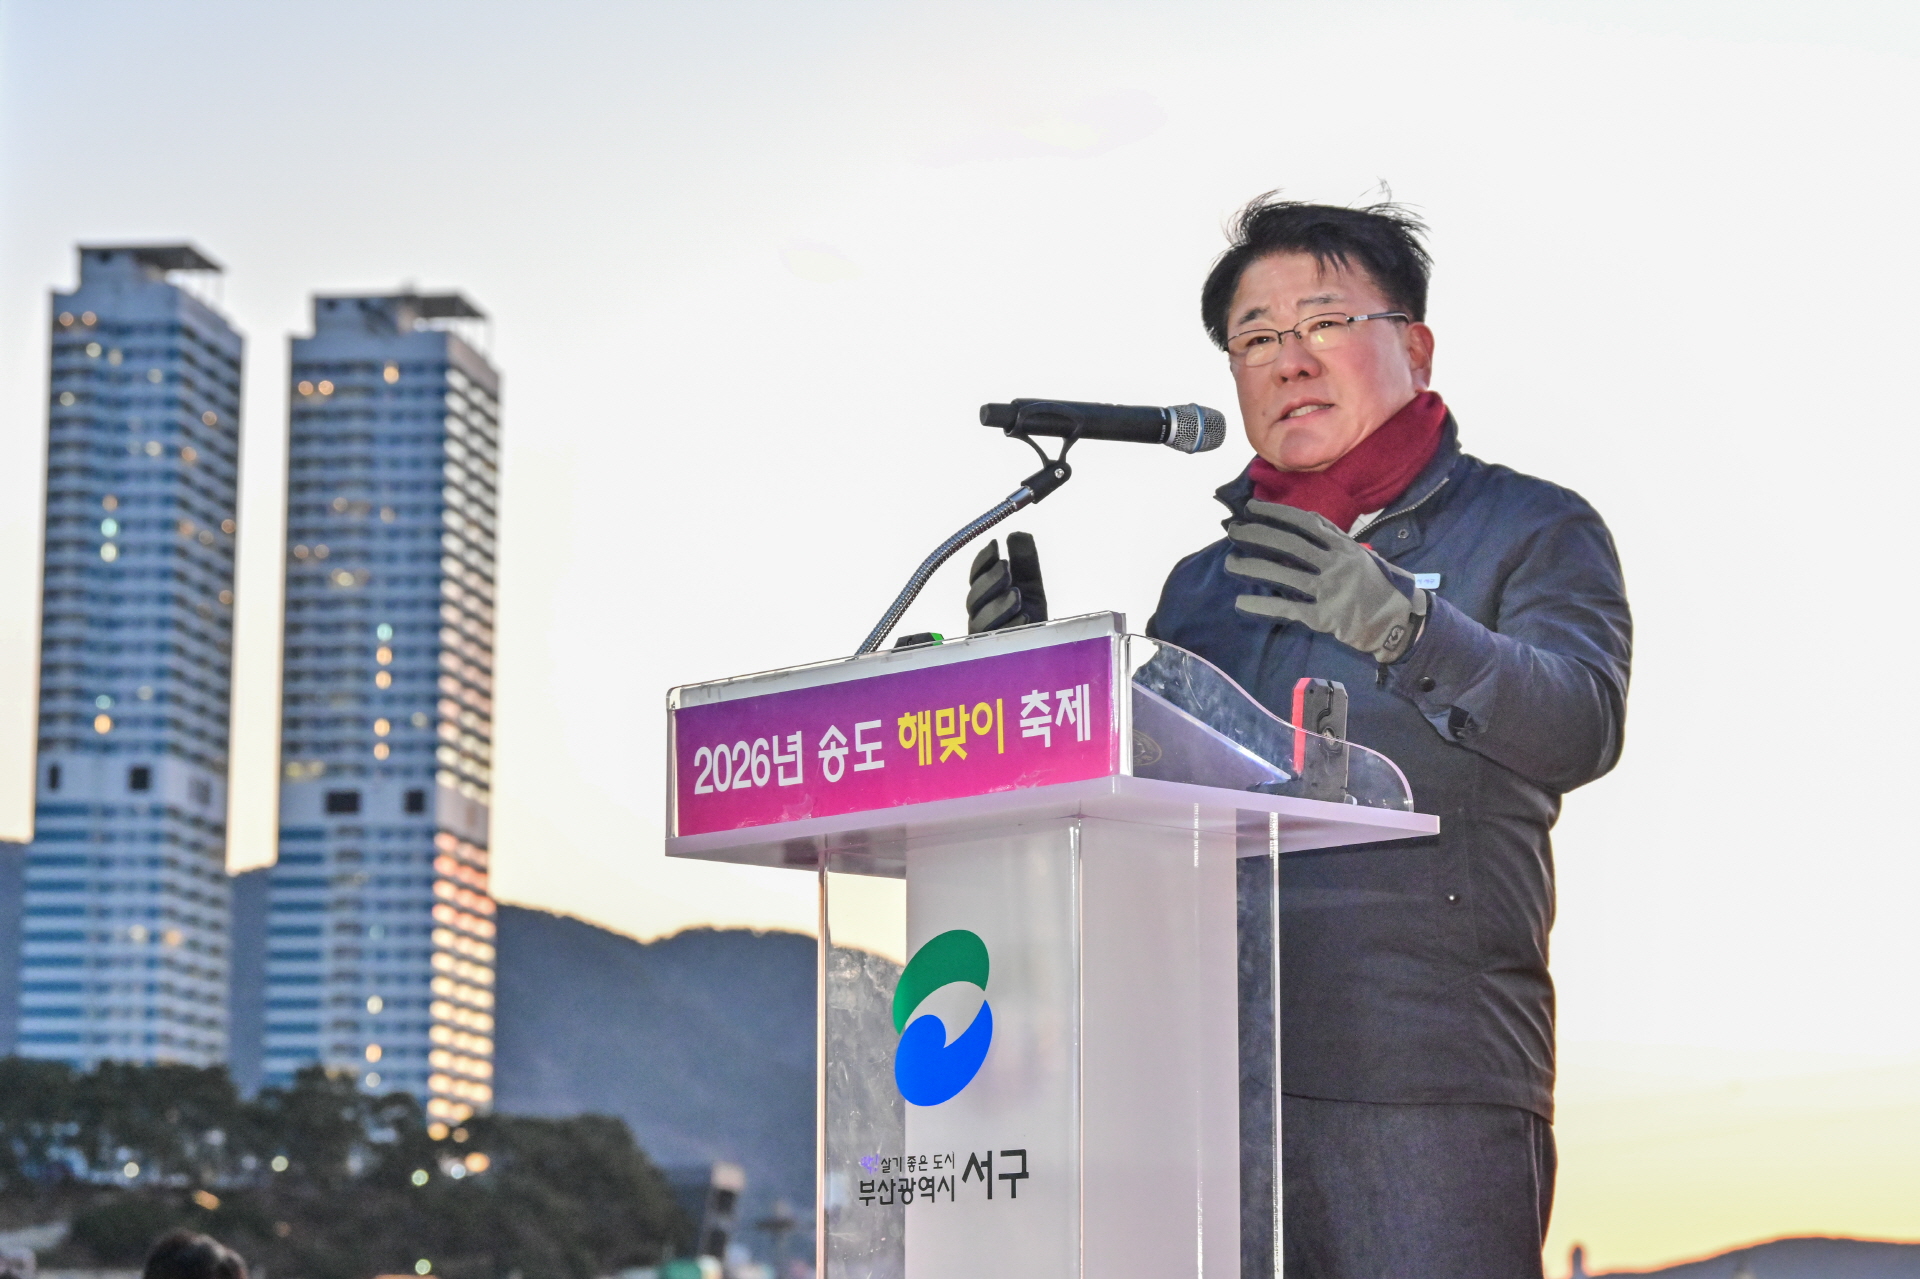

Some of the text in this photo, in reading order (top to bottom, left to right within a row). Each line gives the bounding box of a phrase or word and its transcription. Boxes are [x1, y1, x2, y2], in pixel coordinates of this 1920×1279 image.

[694, 730, 804, 795] 2026년
[818, 719, 885, 783] 송도
[897, 697, 1005, 767] 해맞이
[1019, 683, 1092, 749] 축제
[859, 1148, 1030, 1207] 부산광역시 서구
[881, 1156, 902, 1173] 살기
[907, 1154, 928, 1173] 좋은
[933, 1151, 955, 1170] 도시
